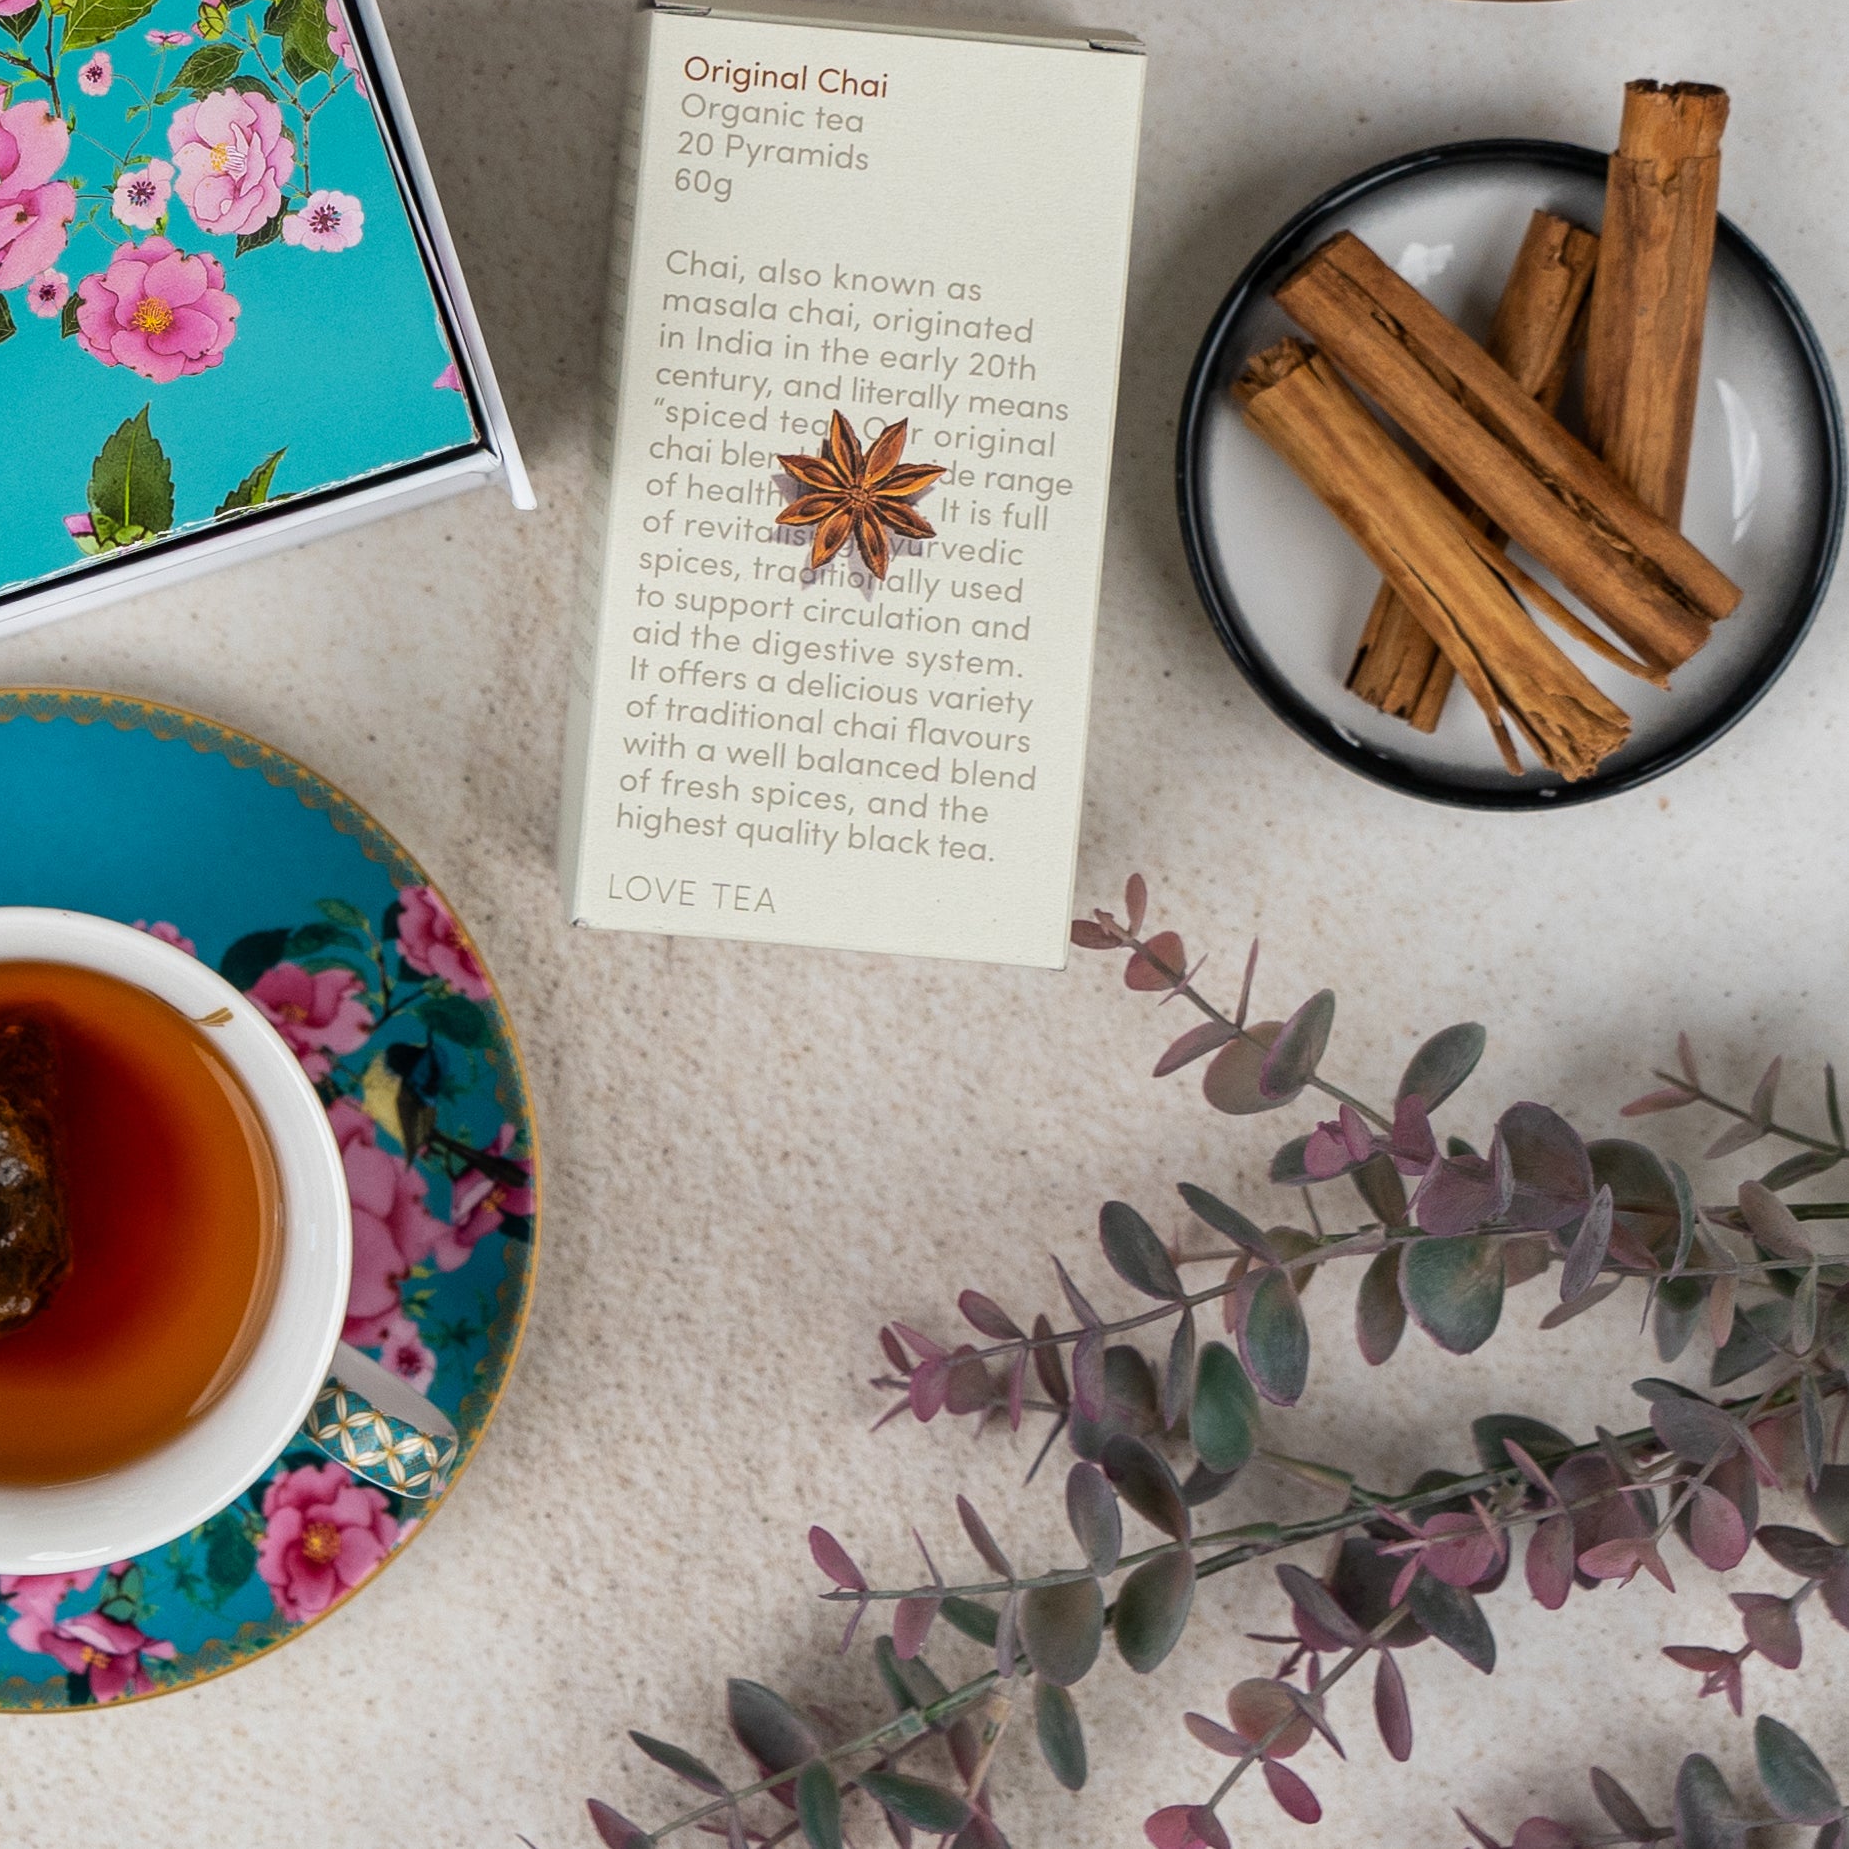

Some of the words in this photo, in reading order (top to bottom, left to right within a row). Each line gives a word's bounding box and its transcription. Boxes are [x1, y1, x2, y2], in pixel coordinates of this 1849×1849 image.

[684, 55, 808, 93] Original
[818, 68, 888, 98] Chai
[681, 92, 805, 129] Organic
[815, 106, 864, 133] tea
[677, 130, 714, 157] 20
[725, 133, 868, 171] Pyramids
[674, 167, 732, 203] 60g
[665, 249, 745, 285] Chai,
[758, 258, 822, 287] also
[833, 263, 935, 298] known
[947, 282, 982, 302] as
[616, 802, 727, 840] highest
[735, 818, 839, 855] quality
[847, 822, 930, 856] black
[939, 834, 994, 862] tea.
[608, 873, 697, 907] LOVE
[711, 882, 776, 914] TEA
